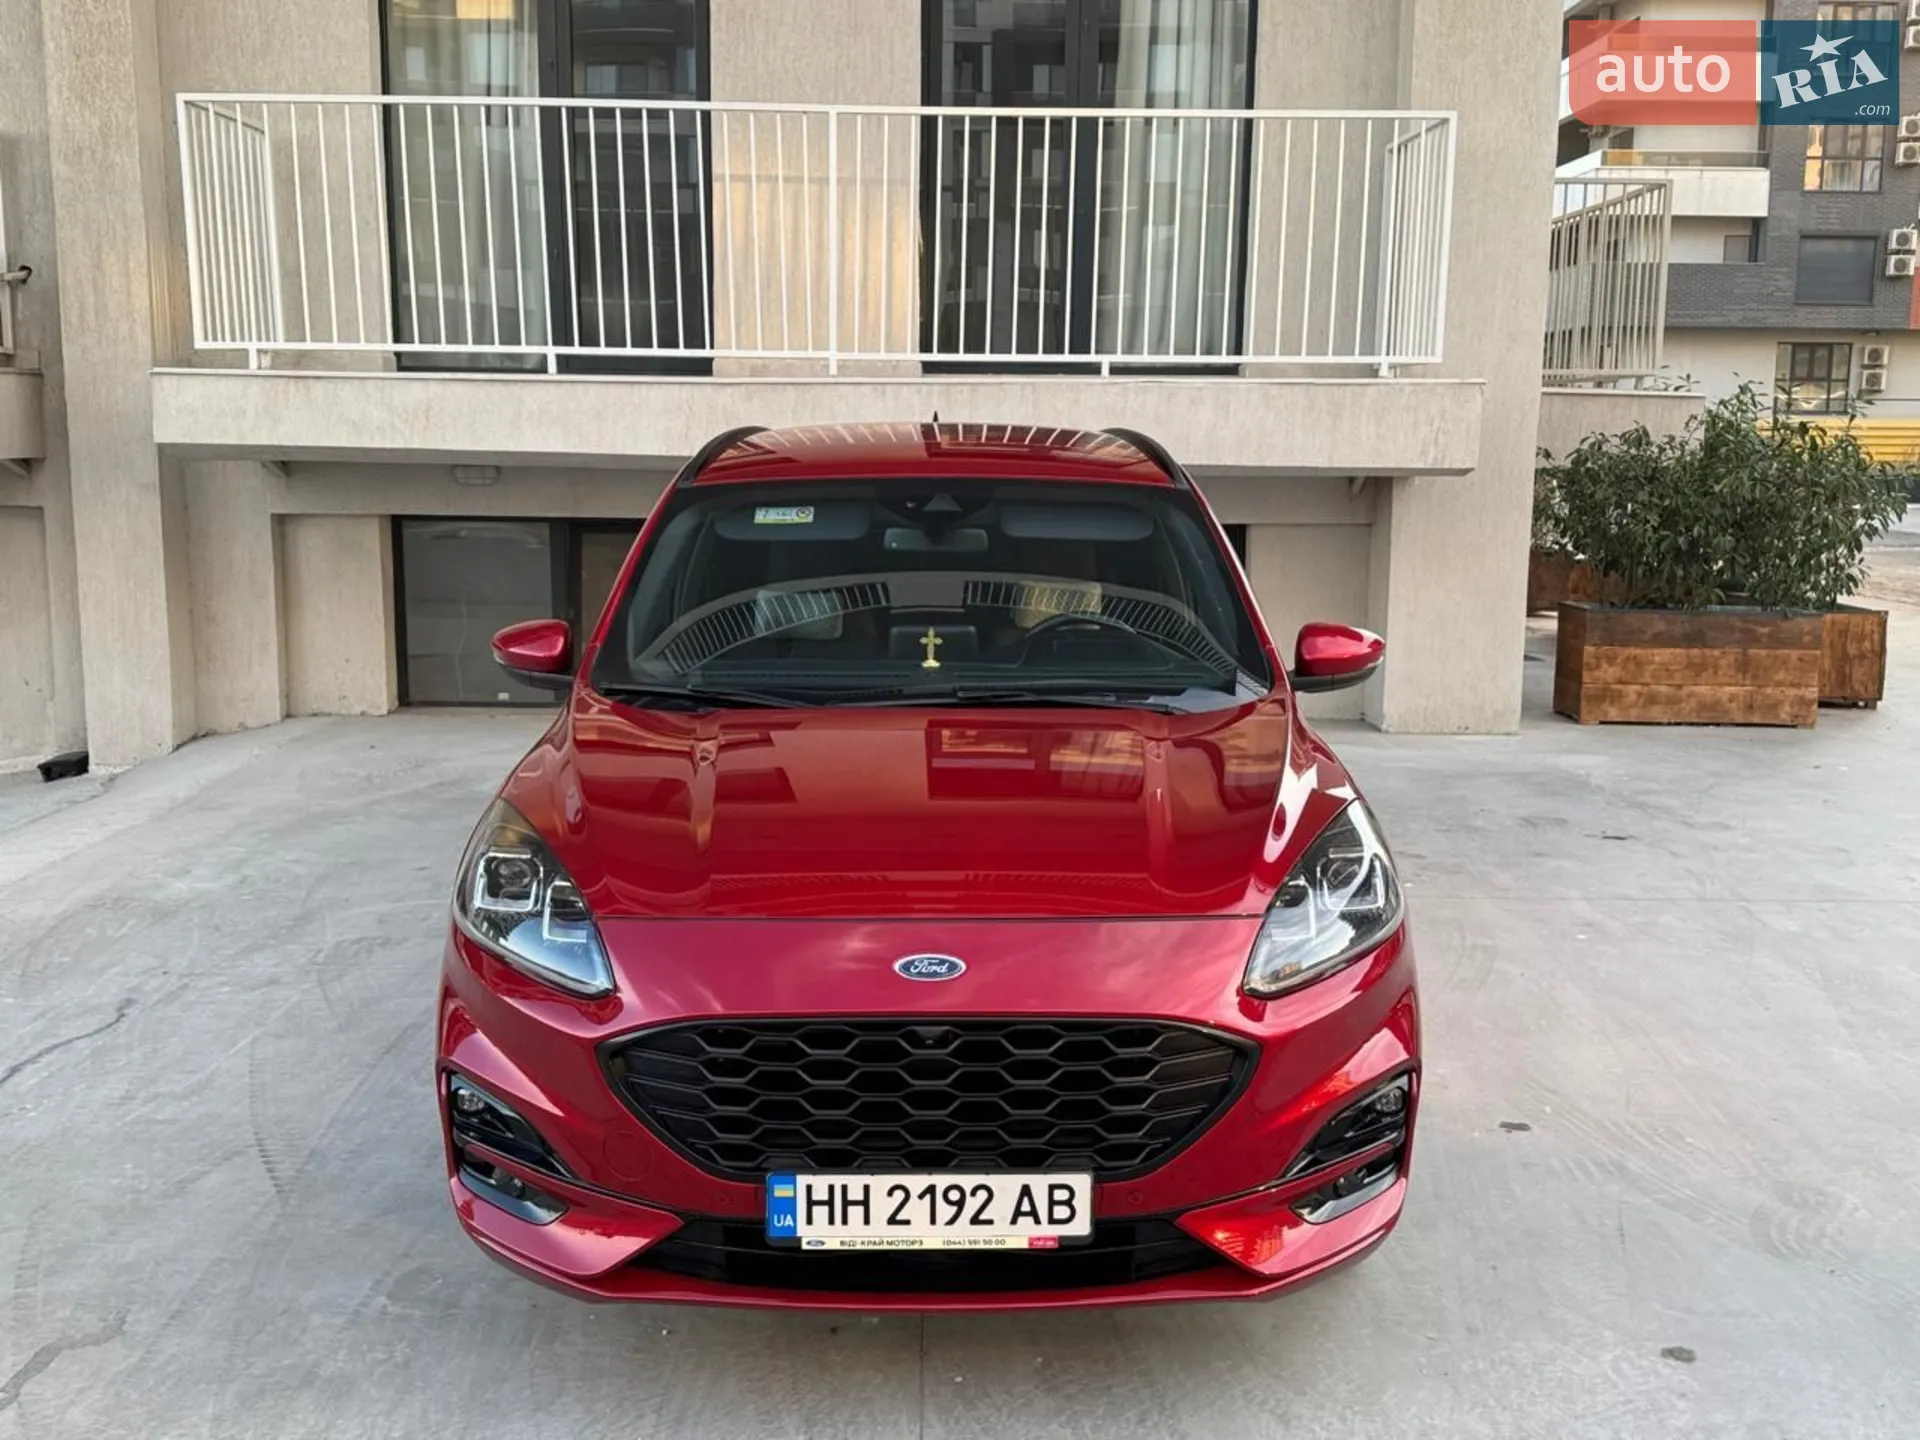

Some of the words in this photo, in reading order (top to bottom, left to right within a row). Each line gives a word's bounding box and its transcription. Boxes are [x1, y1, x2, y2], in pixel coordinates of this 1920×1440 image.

[910, 959, 949, 973] Ford
[805, 1184, 871, 1226] HH
[886, 1184, 995, 1226] 2192
[1009, 1184, 1077, 1226] AB
[774, 1215, 794, 1228] UA
